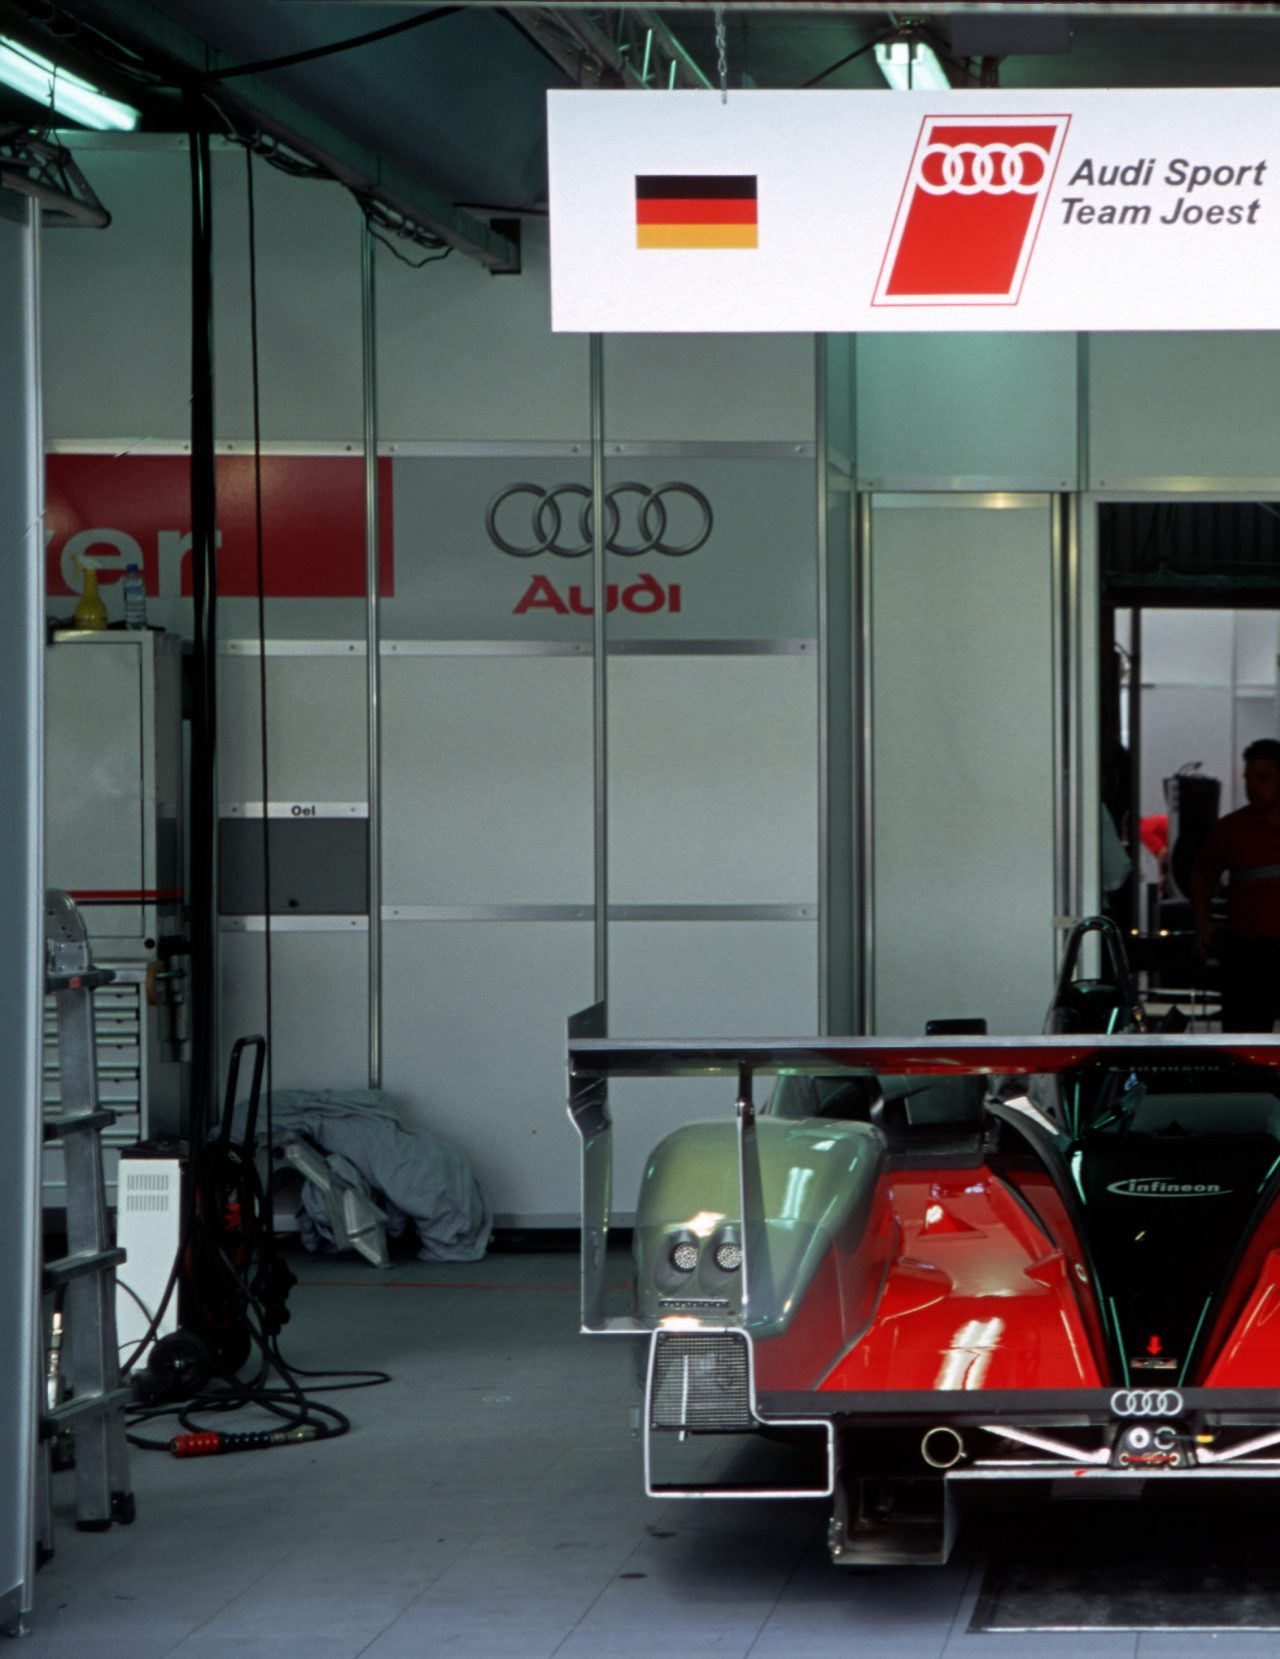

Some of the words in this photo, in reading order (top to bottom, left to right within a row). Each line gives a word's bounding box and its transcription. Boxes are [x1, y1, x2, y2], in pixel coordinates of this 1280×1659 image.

[1068, 157, 1157, 187] Audi
[1164, 158, 1267, 194] Sport
[1060, 197, 1151, 226] Team
[1160, 197, 1261, 226] Joest
[46, 527, 223, 600] er
[513, 573, 681, 616] Audi
[291, 805, 316, 817] Oel
